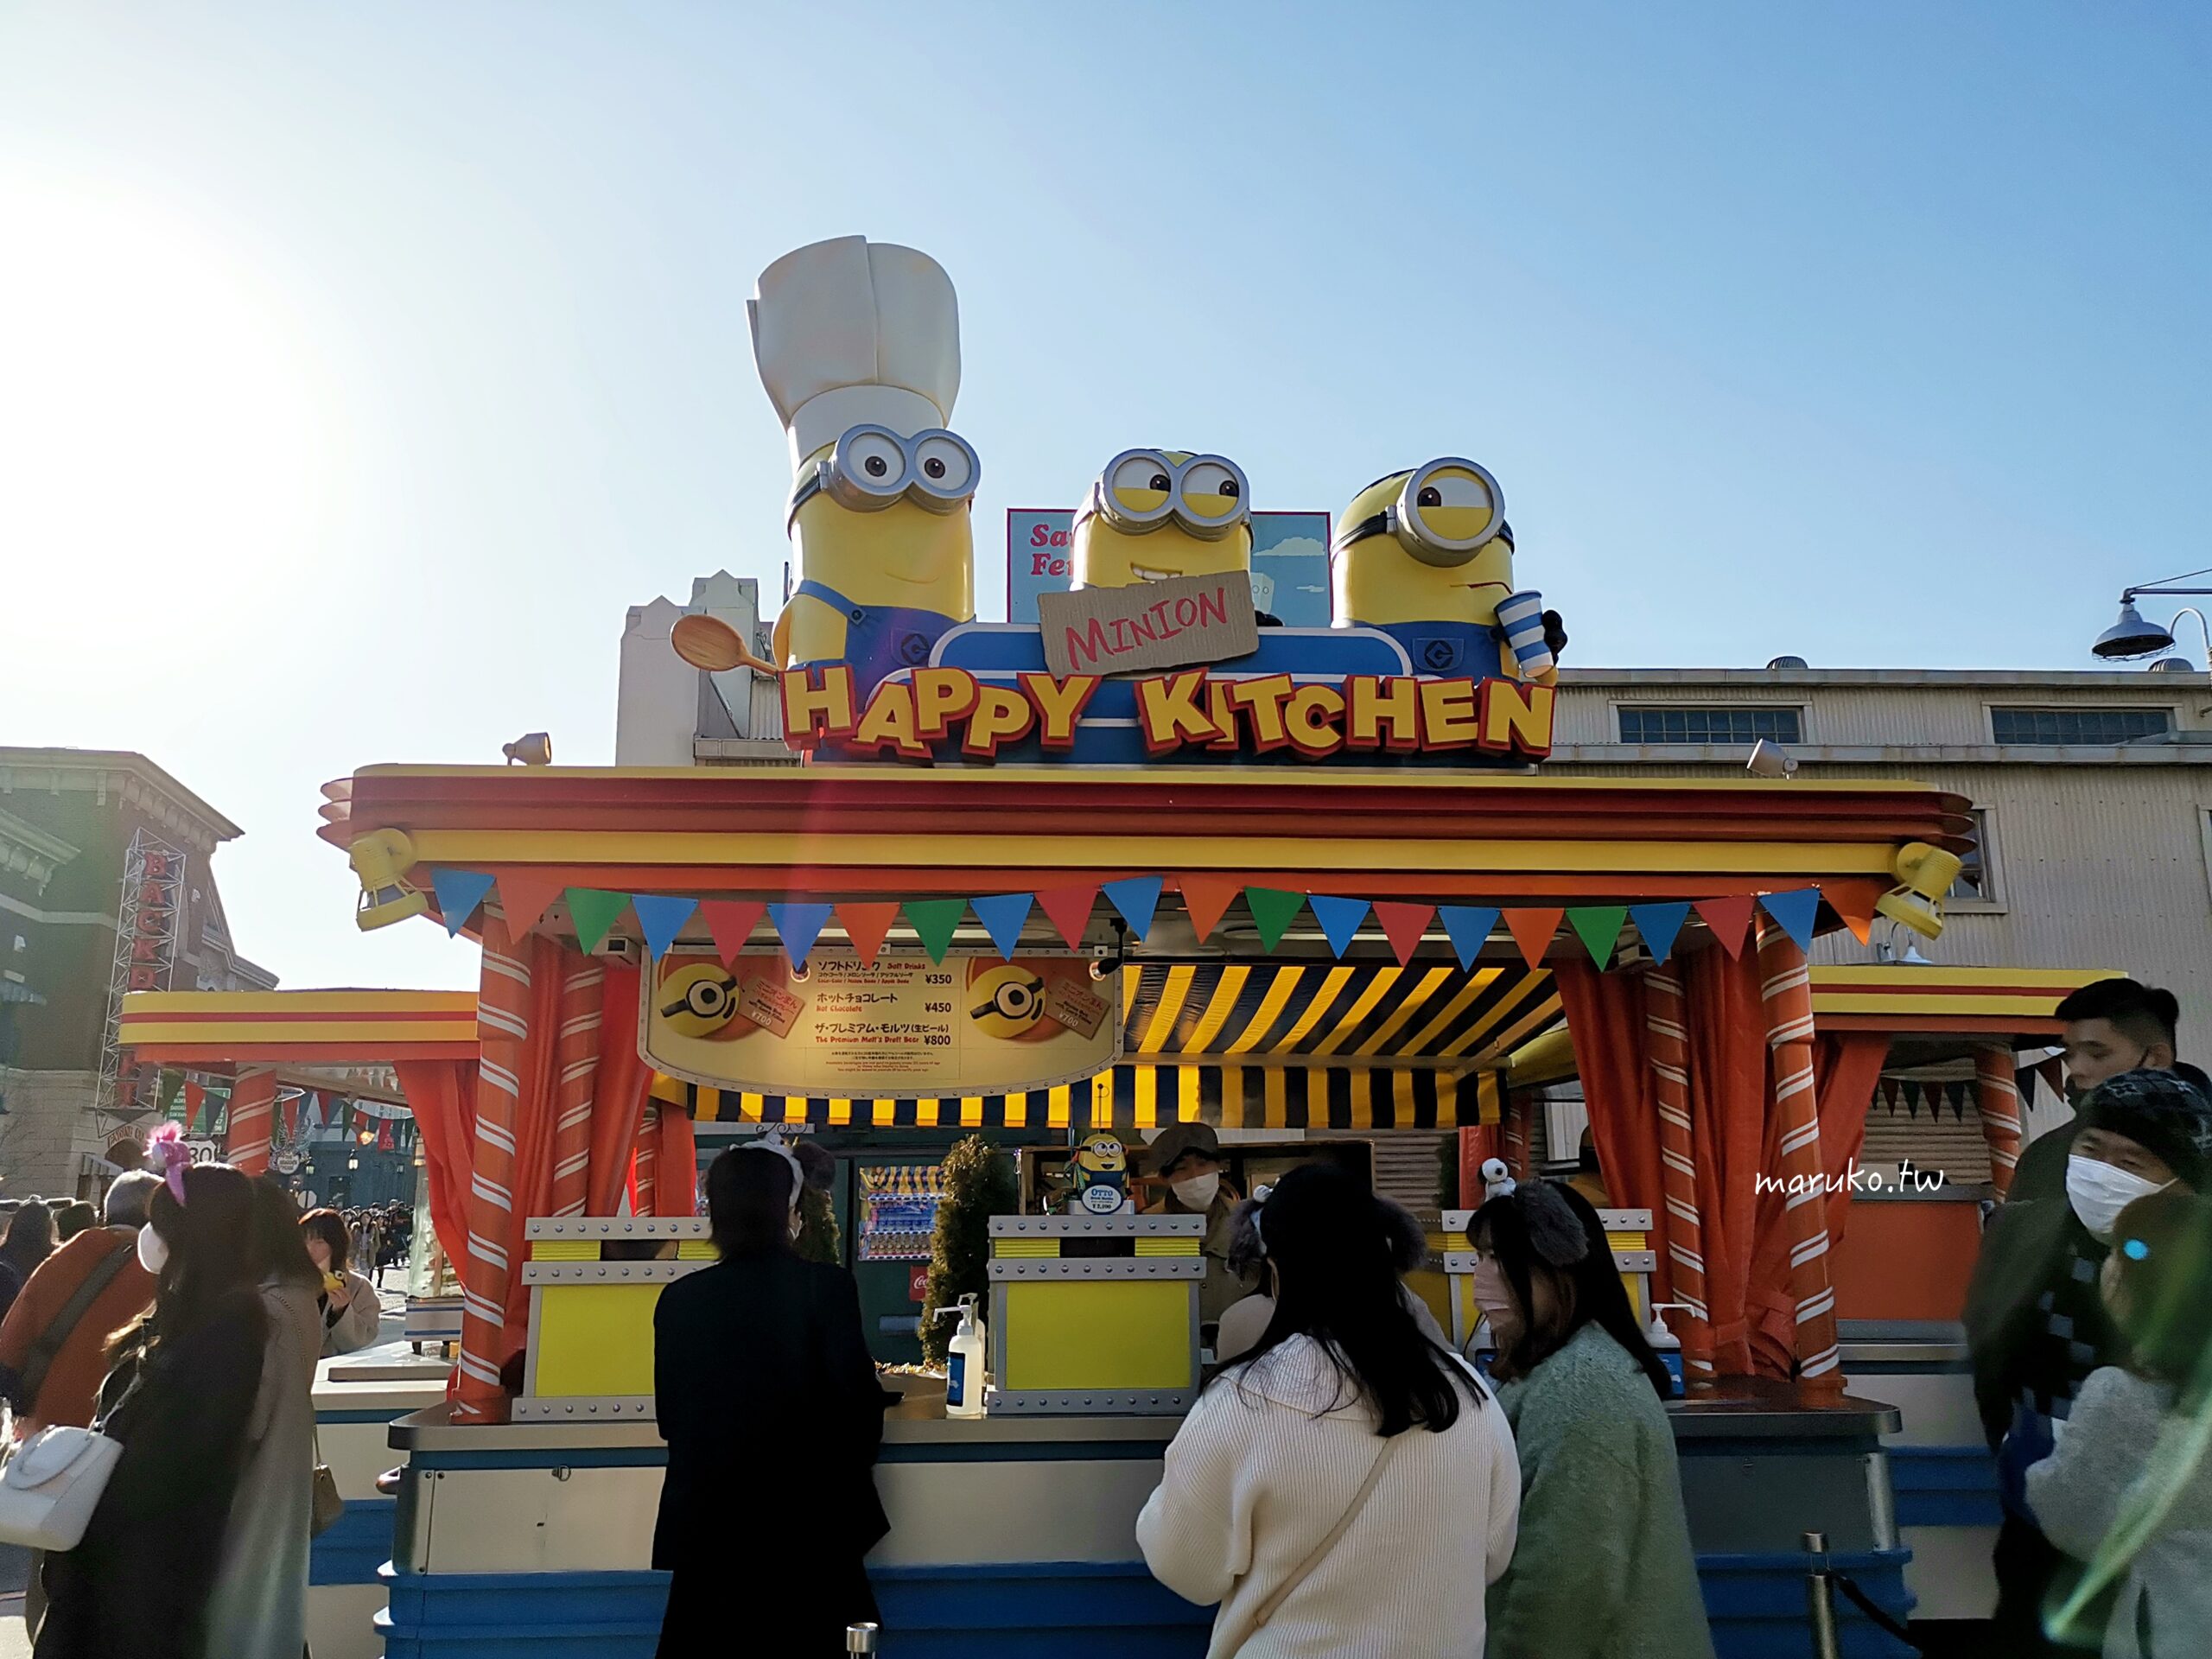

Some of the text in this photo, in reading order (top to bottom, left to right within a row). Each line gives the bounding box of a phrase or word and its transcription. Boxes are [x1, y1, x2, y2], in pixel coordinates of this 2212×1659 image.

[1065, 588, 1227, 671] MINION
[779, 664, 1555, 762] HAPPY KITCHEN
[817, 961, 880, 971] ソフトドリク
[925, 974, 952, 984] ¥350
[817, 993, 898, 1003] ホットチョコレート
[925, 1002, 951, 1013] ¥450
[752, 1010, 772, 1027] ¥700
[1059, 1012, 1078, 1027] ¥700
[924, 1035, 951, 1046] ¥800
